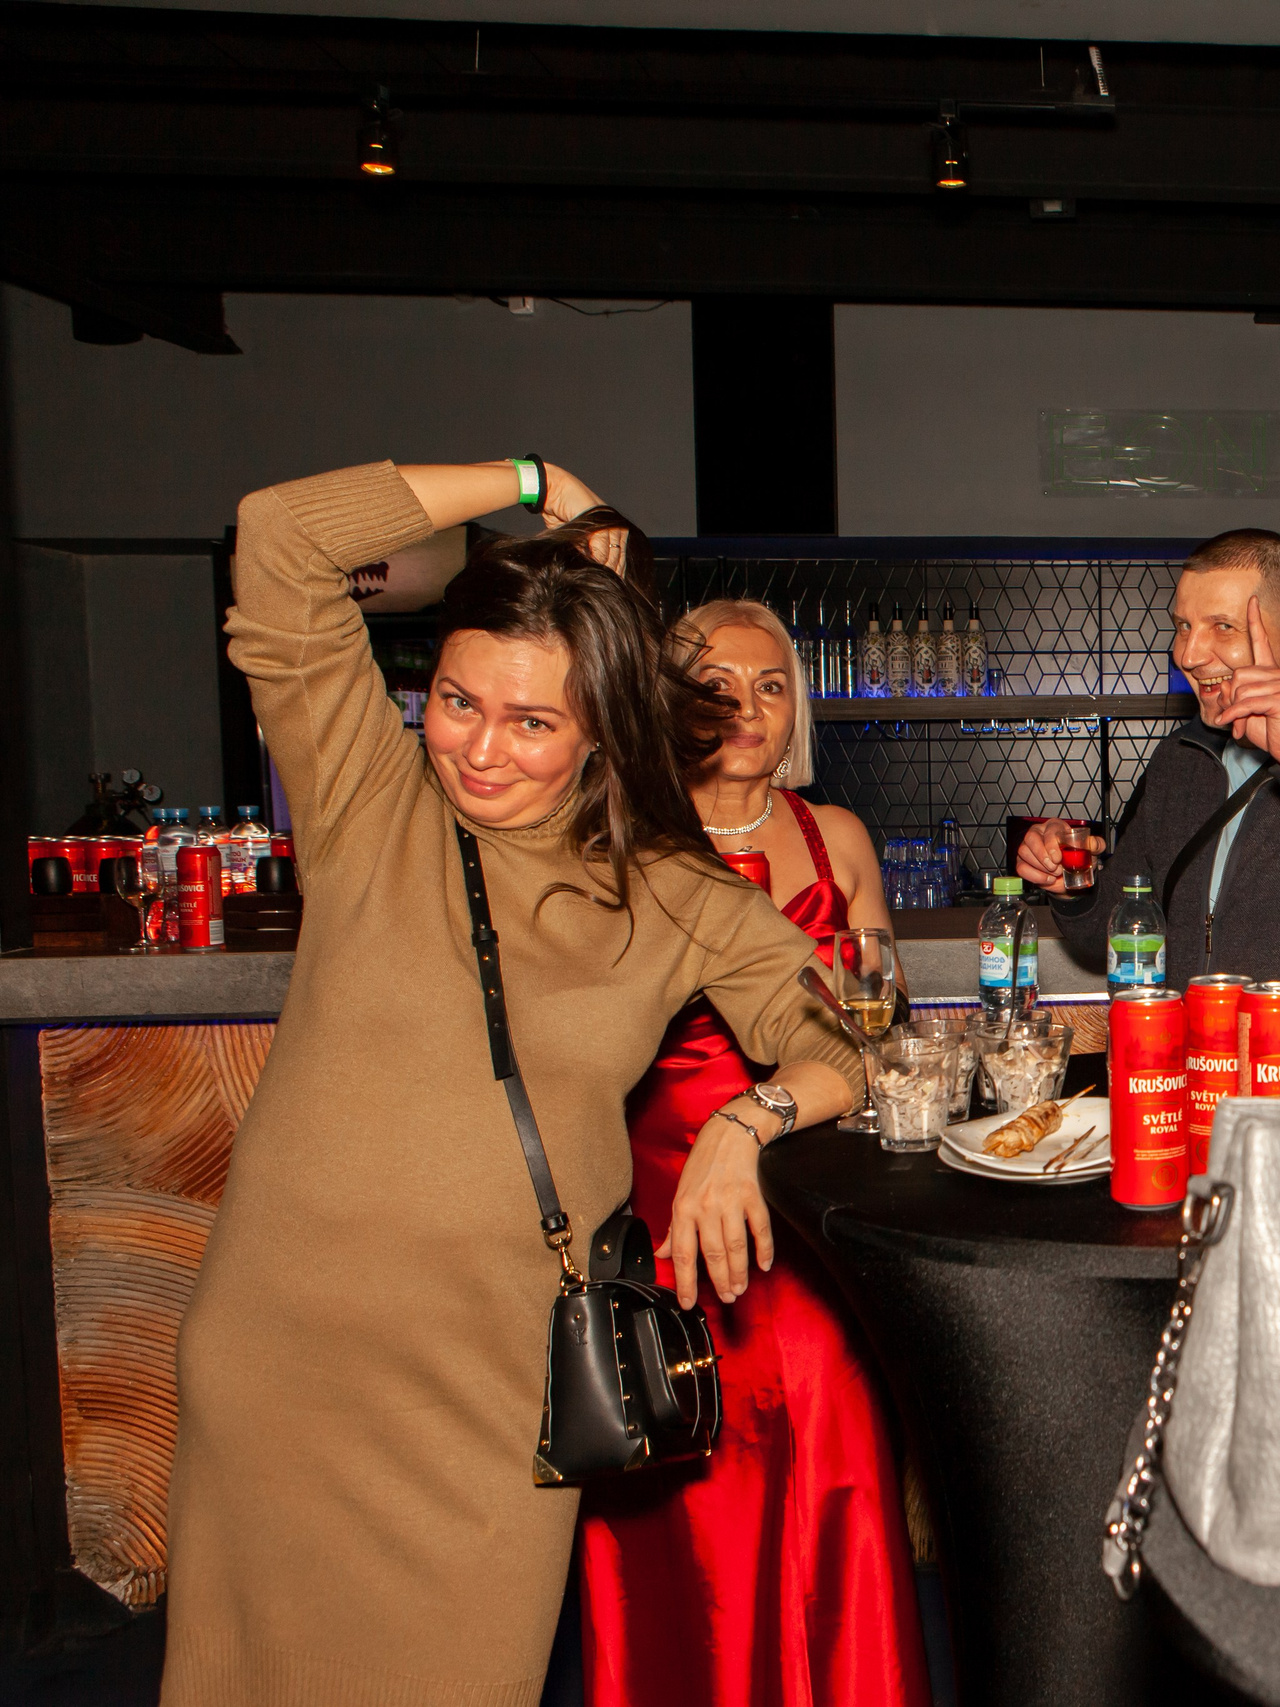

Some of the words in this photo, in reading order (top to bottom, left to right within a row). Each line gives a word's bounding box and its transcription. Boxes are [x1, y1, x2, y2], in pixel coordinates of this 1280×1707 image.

[1195, 1102, 1217, 1112] ROYA
[1142, 1107, 1183, 1126] SVĚTLÉ
[1150, 1124, 1178, 1135] ROYAL
